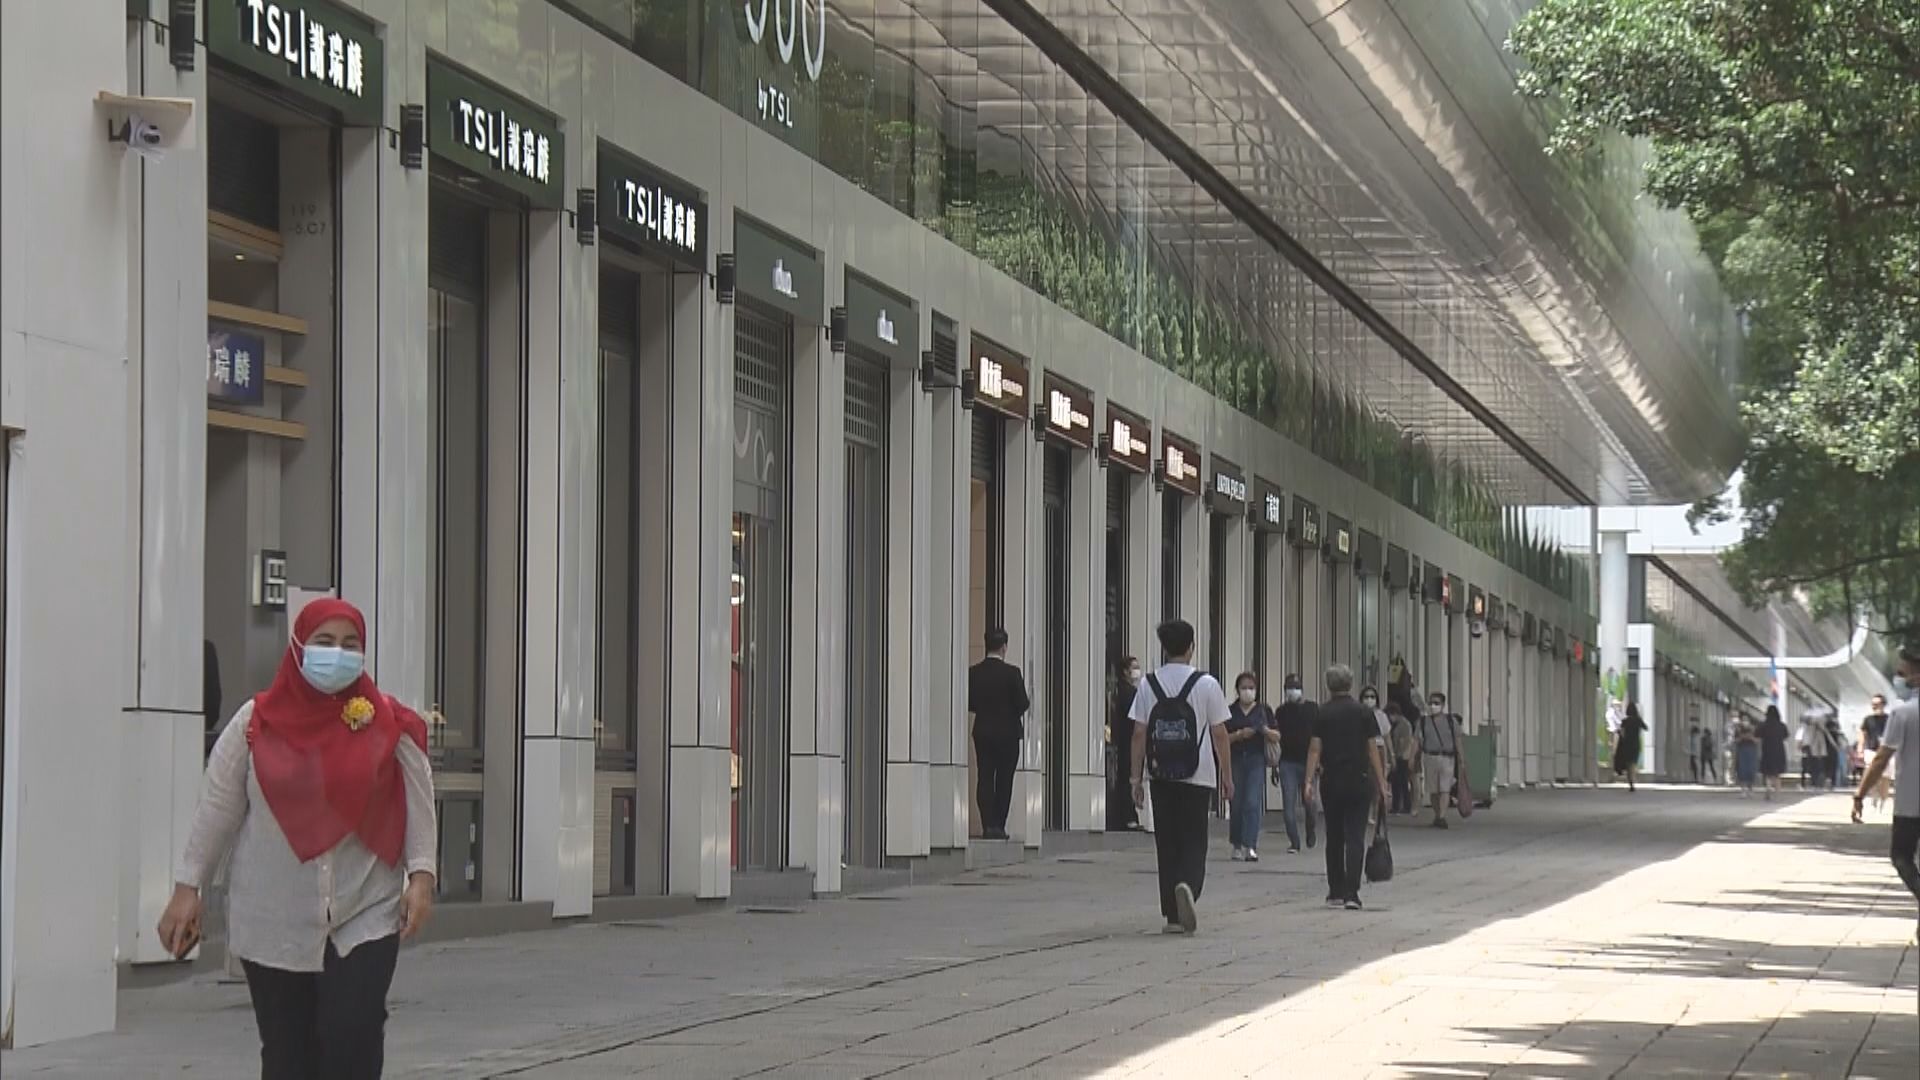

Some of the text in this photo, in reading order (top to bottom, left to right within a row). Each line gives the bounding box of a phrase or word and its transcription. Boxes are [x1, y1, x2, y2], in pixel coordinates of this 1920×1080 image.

[247, 0, 298, 63] TSL
[460, 99, 499, 158] TSL
[758, 78, 793, 128] by TSL
[625, 179, 656, 230] TSL
[207, 344, 251, 388] 瑞麟
